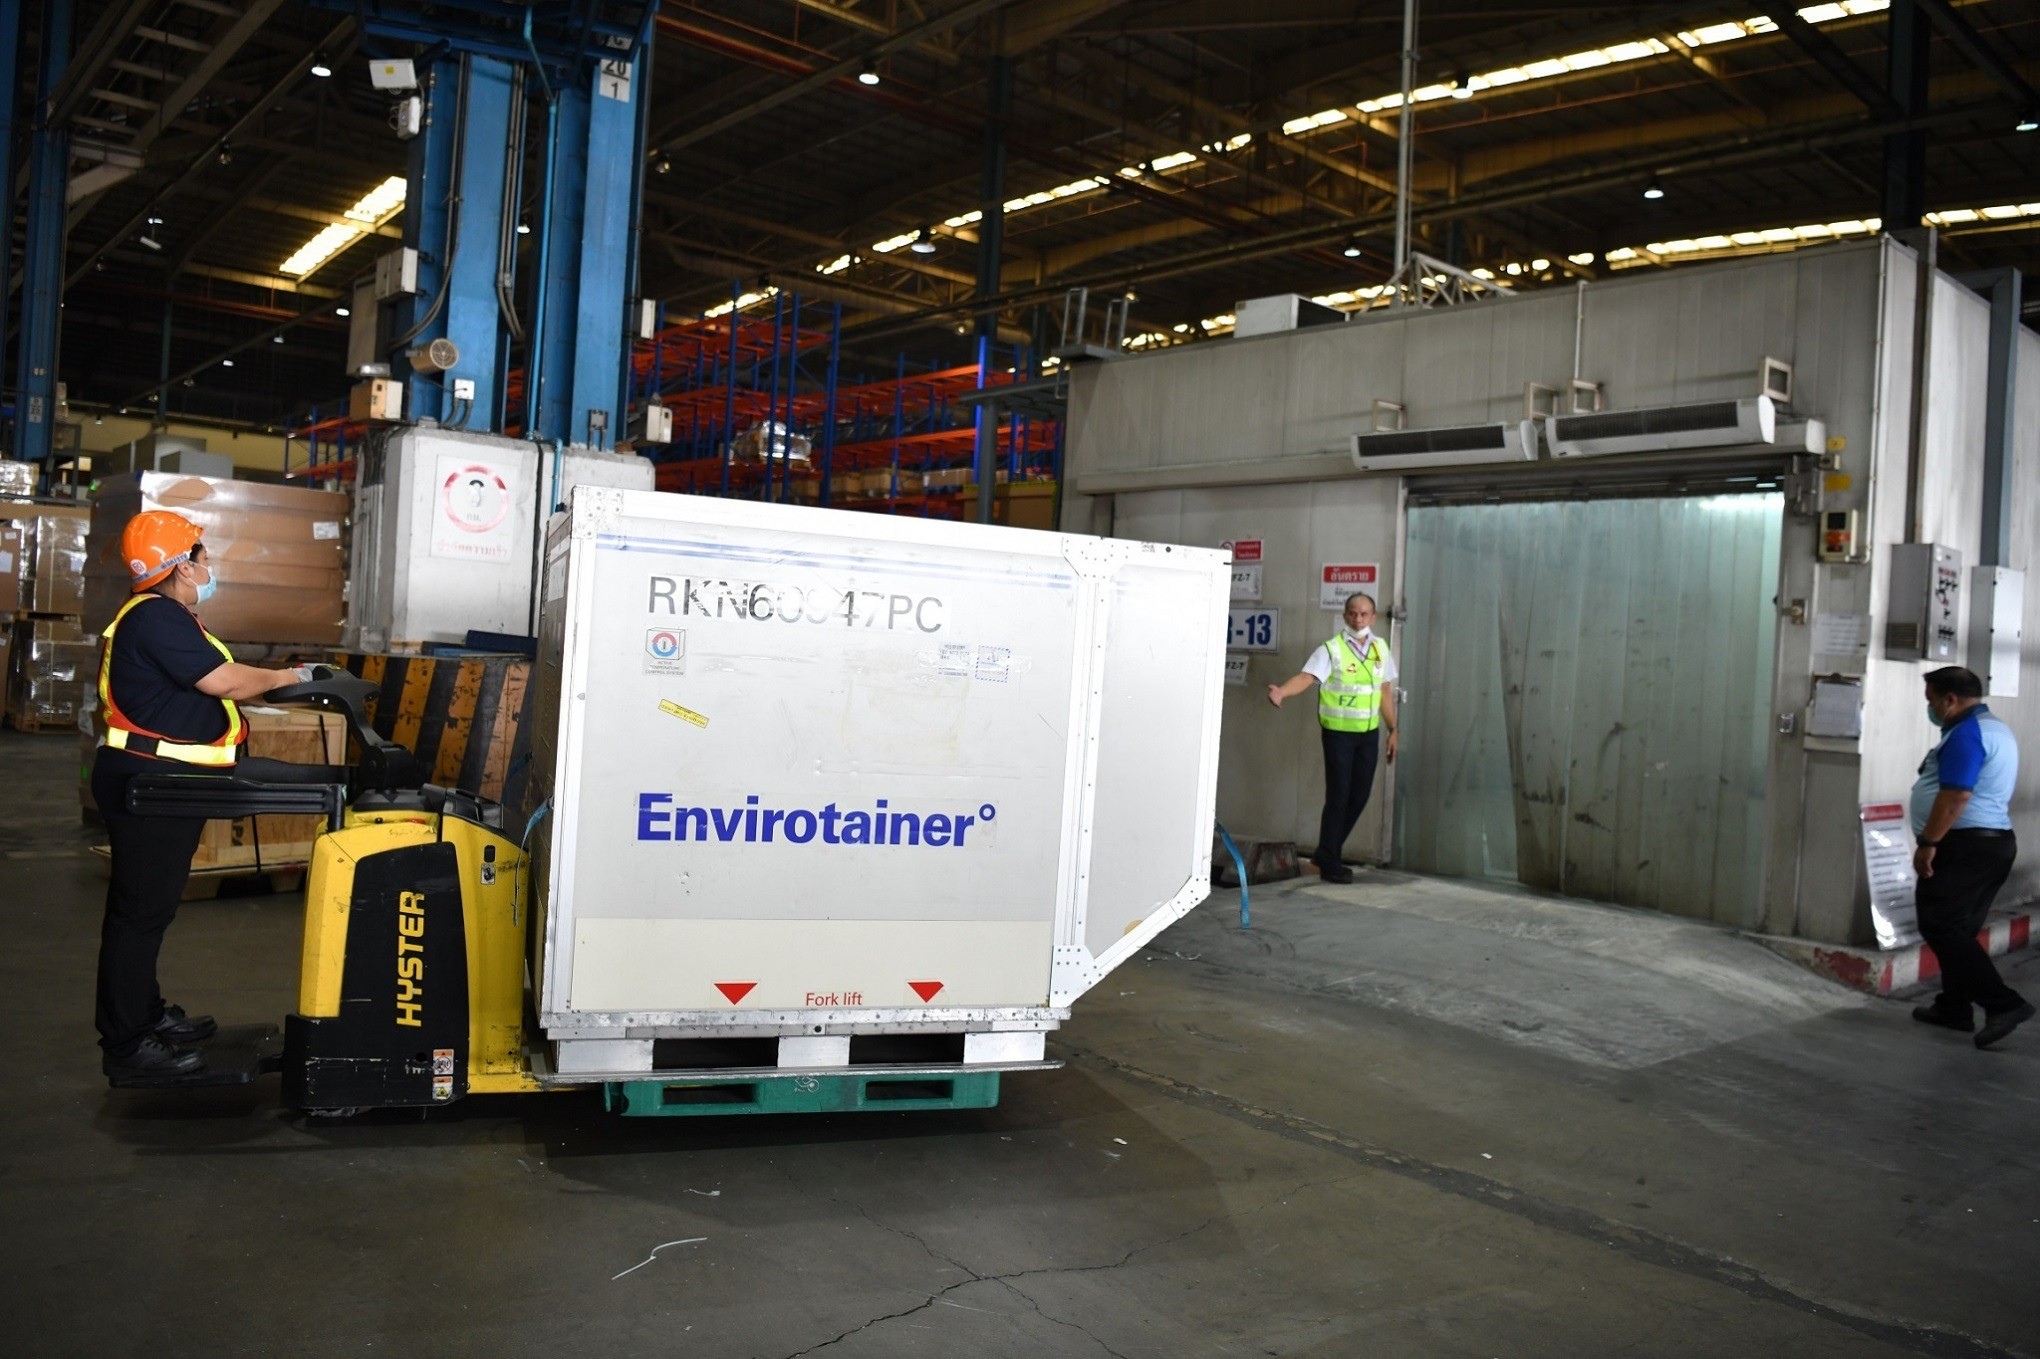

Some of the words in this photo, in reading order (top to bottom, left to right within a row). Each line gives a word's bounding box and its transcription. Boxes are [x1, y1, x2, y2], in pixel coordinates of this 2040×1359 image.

[611, 82, 618, 98] 1
[1339, 695, 1357, 707] FZ
[396, 891, 425, 1027] HYSTER
[806, 992, 839, 1006] Fork
[843, 992, 863, 1005] lift
